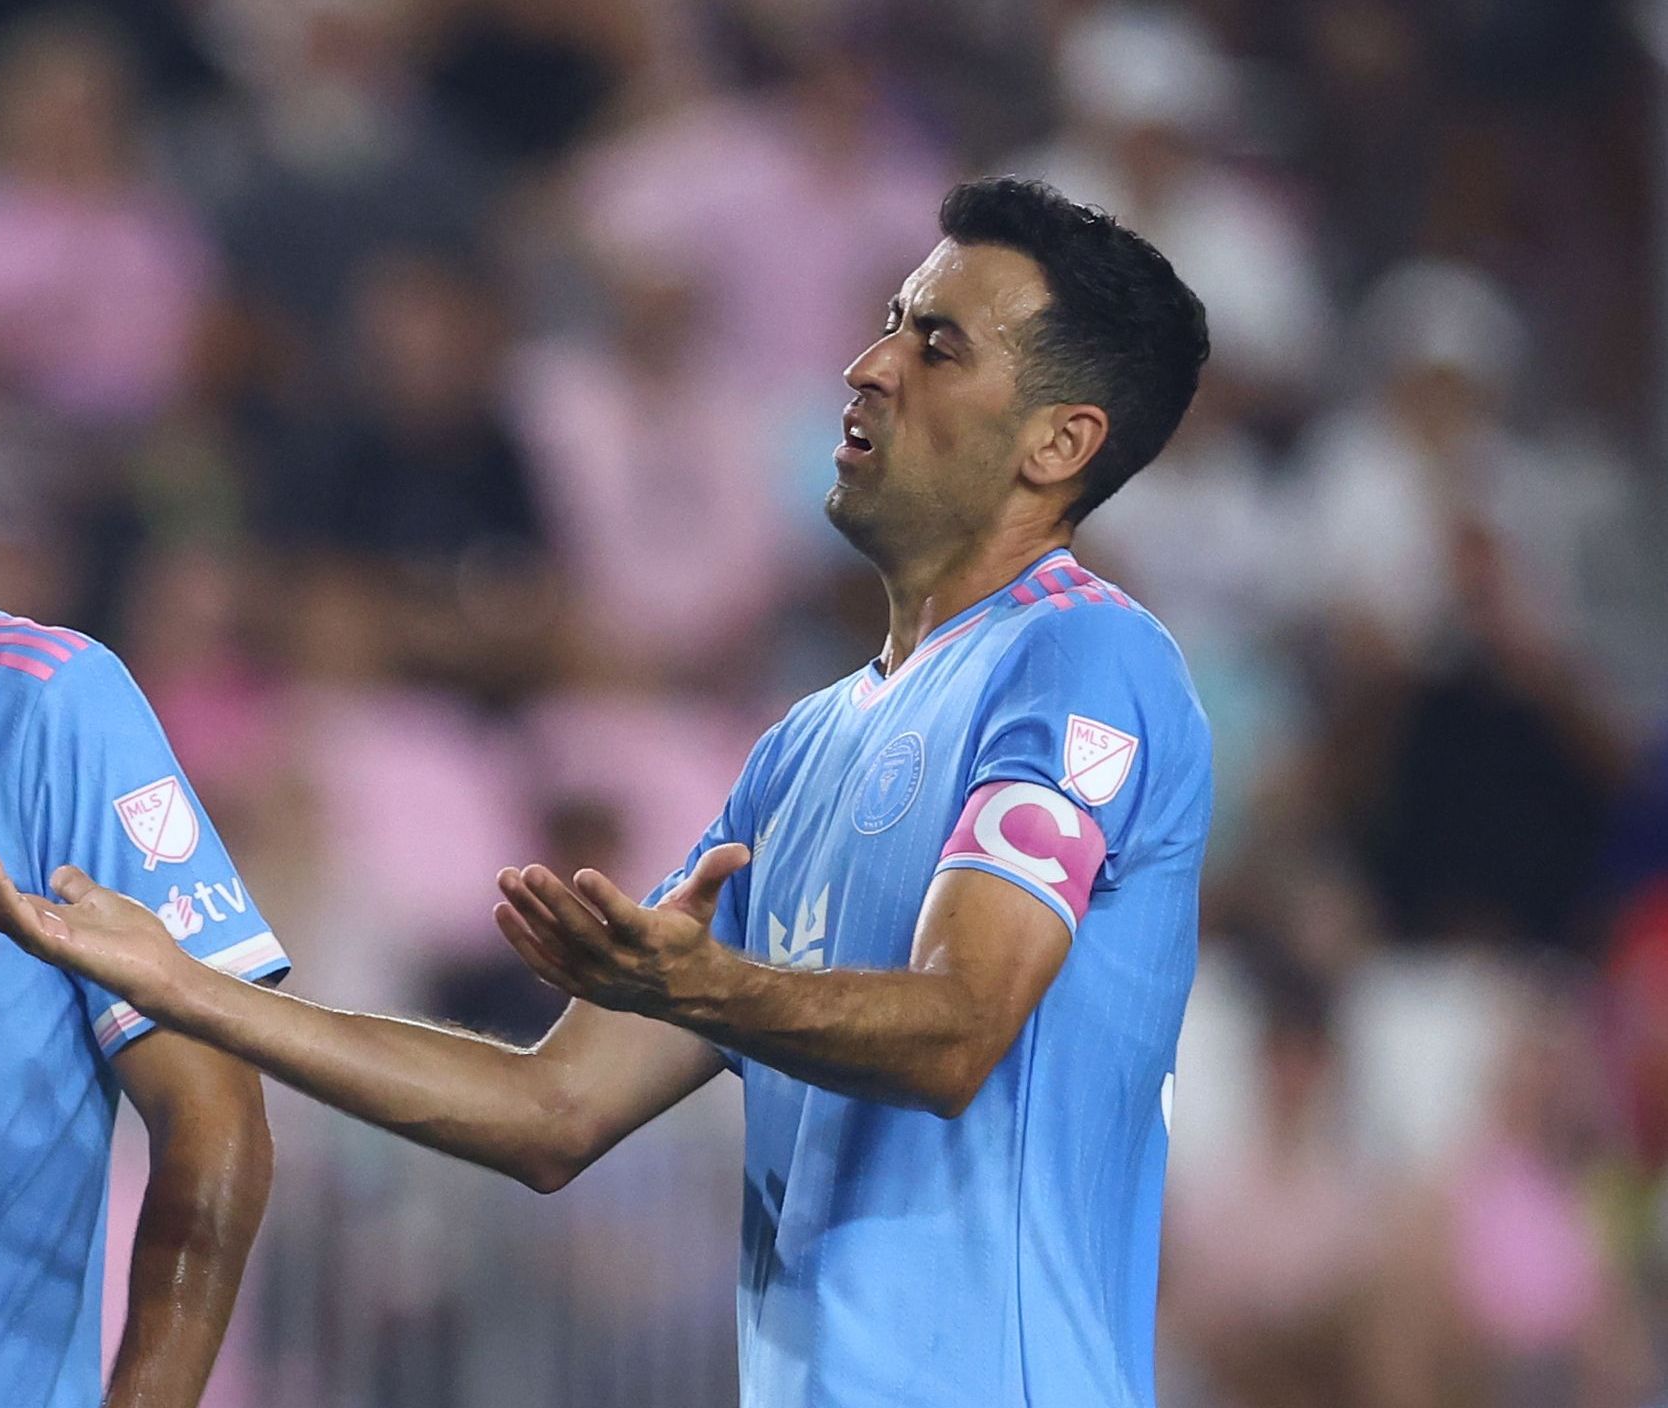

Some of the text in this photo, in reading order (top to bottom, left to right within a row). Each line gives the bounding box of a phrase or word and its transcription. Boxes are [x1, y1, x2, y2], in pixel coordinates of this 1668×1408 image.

[1075, 726, 1110, 750] MLS
[125, 793, 163, 819] MLS
[973, 782, 1081, 884] C
